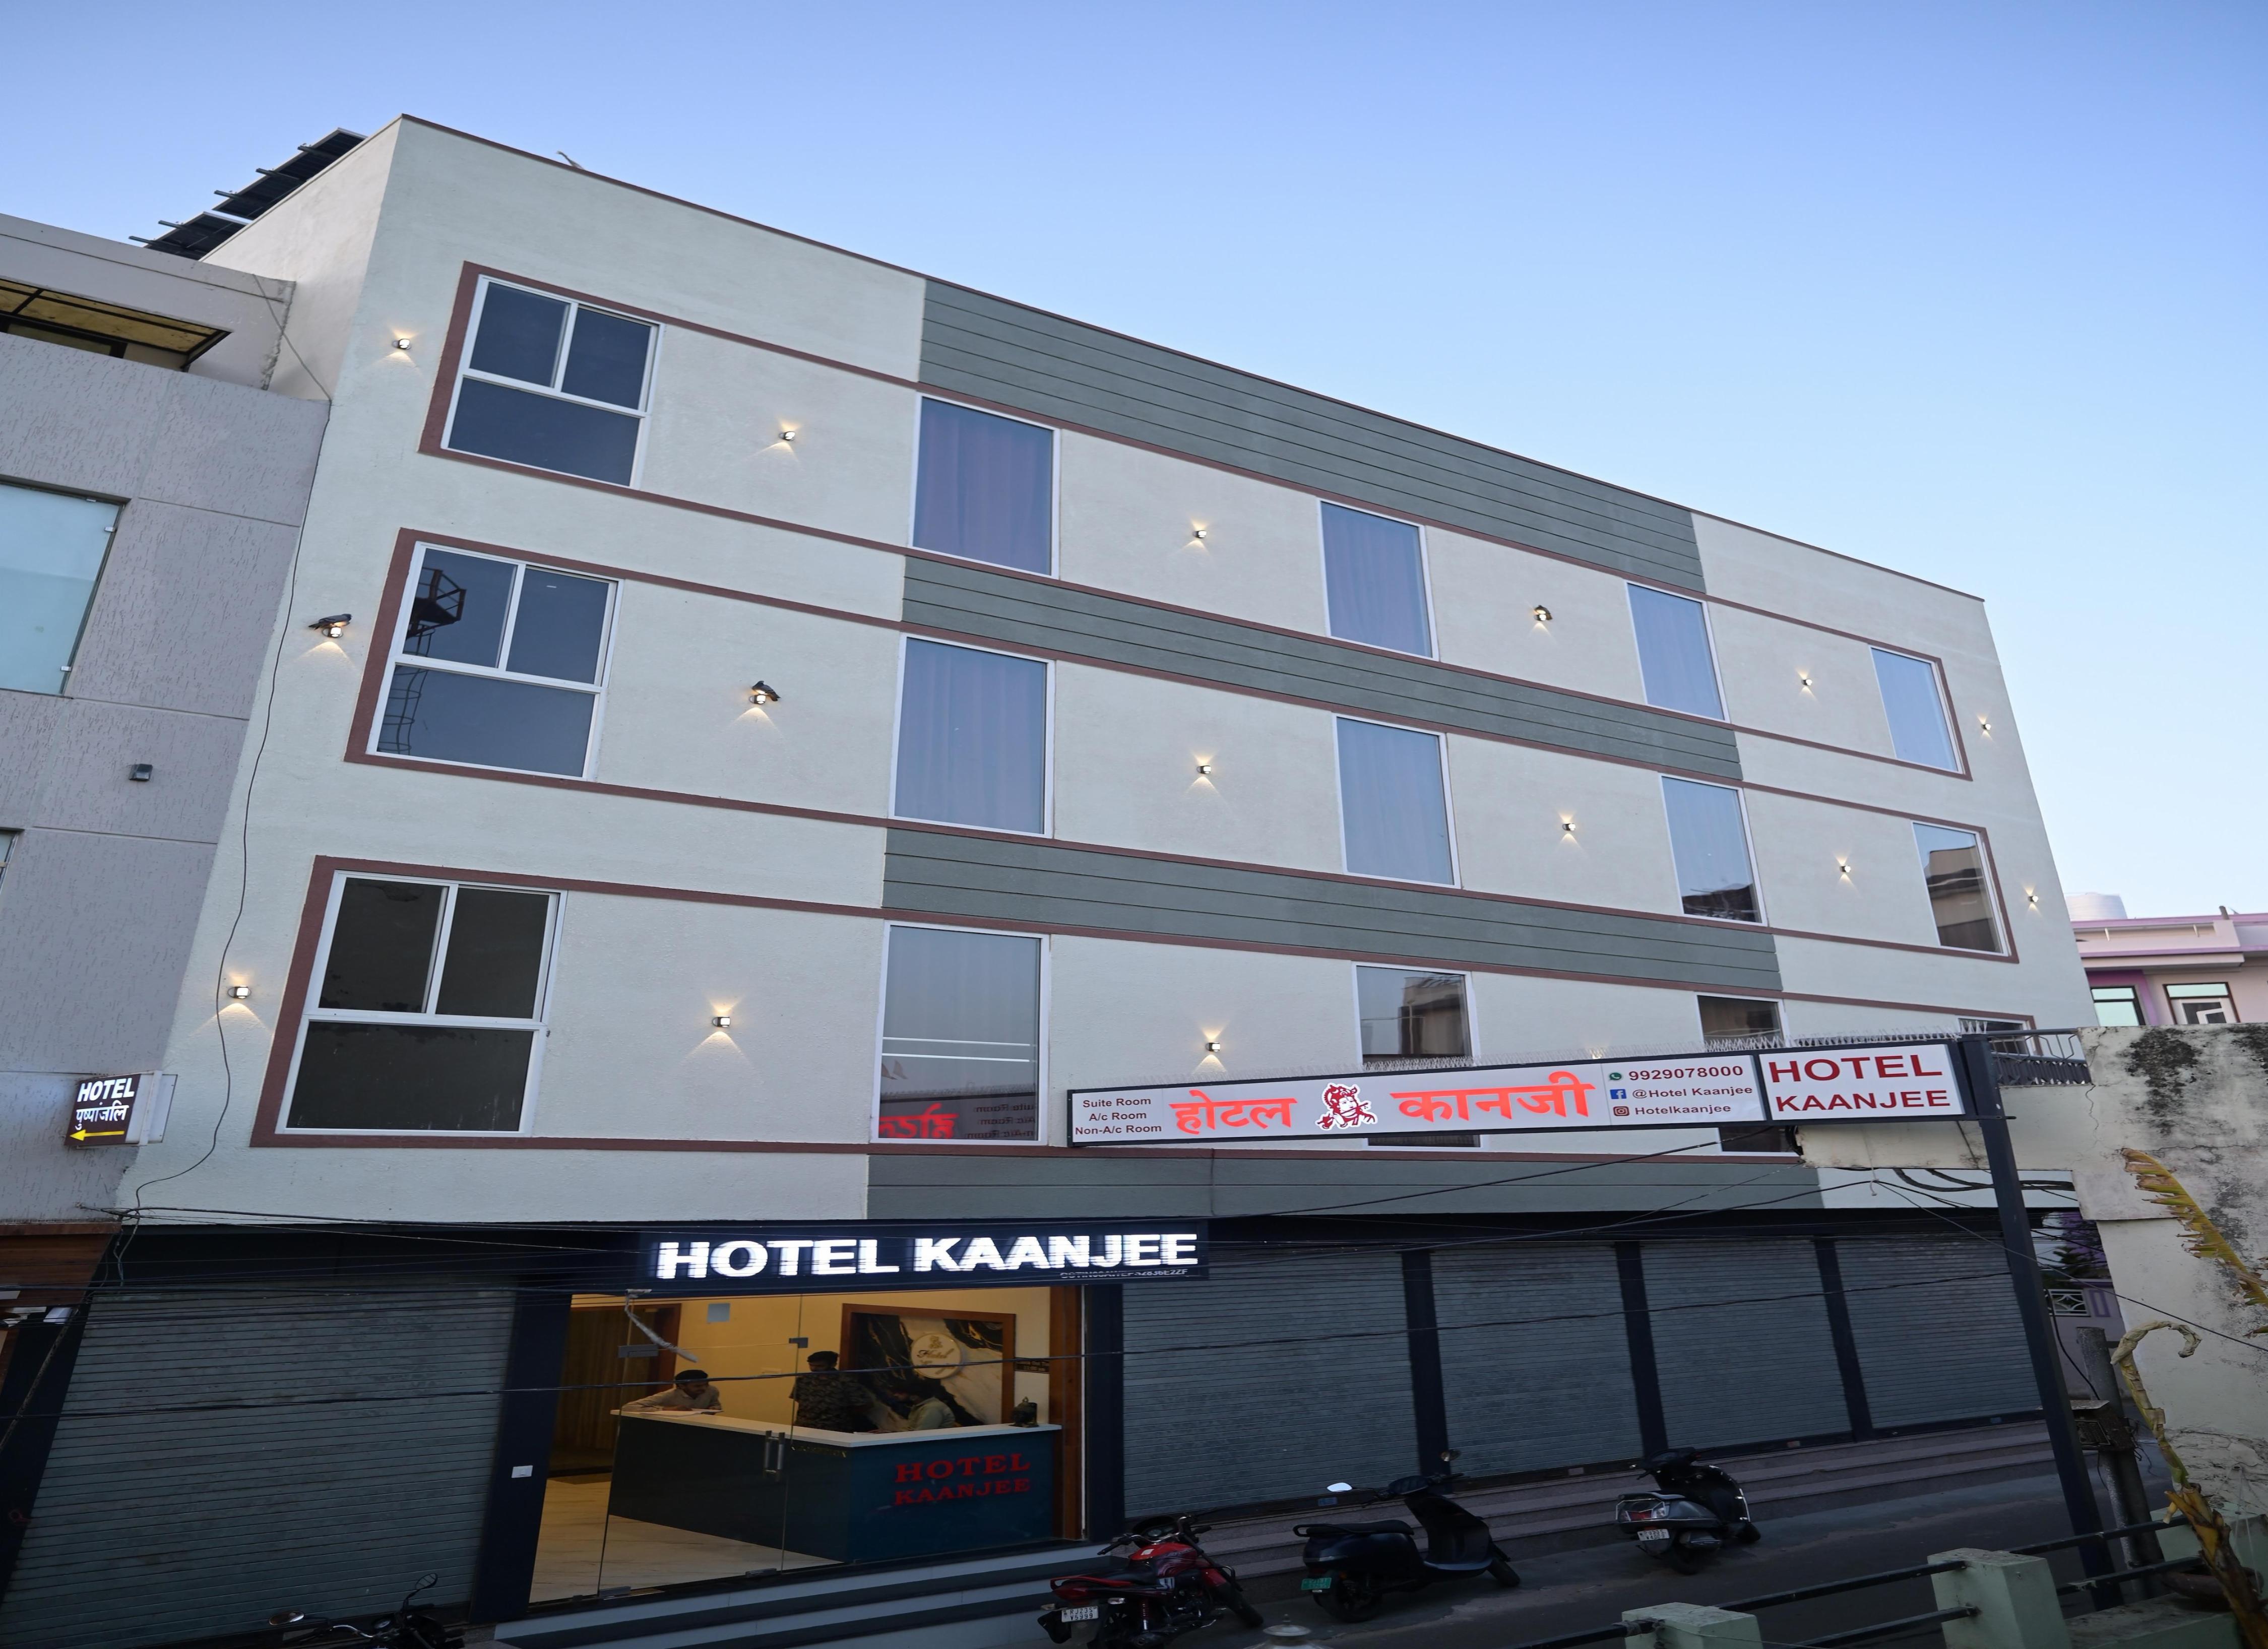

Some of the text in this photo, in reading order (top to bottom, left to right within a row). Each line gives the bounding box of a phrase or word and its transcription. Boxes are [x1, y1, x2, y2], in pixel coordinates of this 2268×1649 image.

[1628, 1065, 1743, 1081] 9929078000
[1769, 1054, 1943, 1083] HOTEL
[77, 1077, 135, 1102] HOTEL
[1632, 1086, 1753, 1099] @Hotel Kaanjee
[1083, 1098, 1151, 1108] Suite Room
[1169, 1071, 1596, 1134] होटल कानजी
[1635, 1104, 1731, 1115] Hotelkaanjee
[1776, 1090, 1950, 1112] KAANJEE
[1089, 1111, 1147, 1121] A/c Room
[1075, 1124, 1162, 1135] Non-A/c Room
[657, 1233, 1199, 1279] HOTEL KAANJEE
[895, 1453, 1031, 1483] HOTEL
[895, 1478, 1030, 1506] KAANJEE
